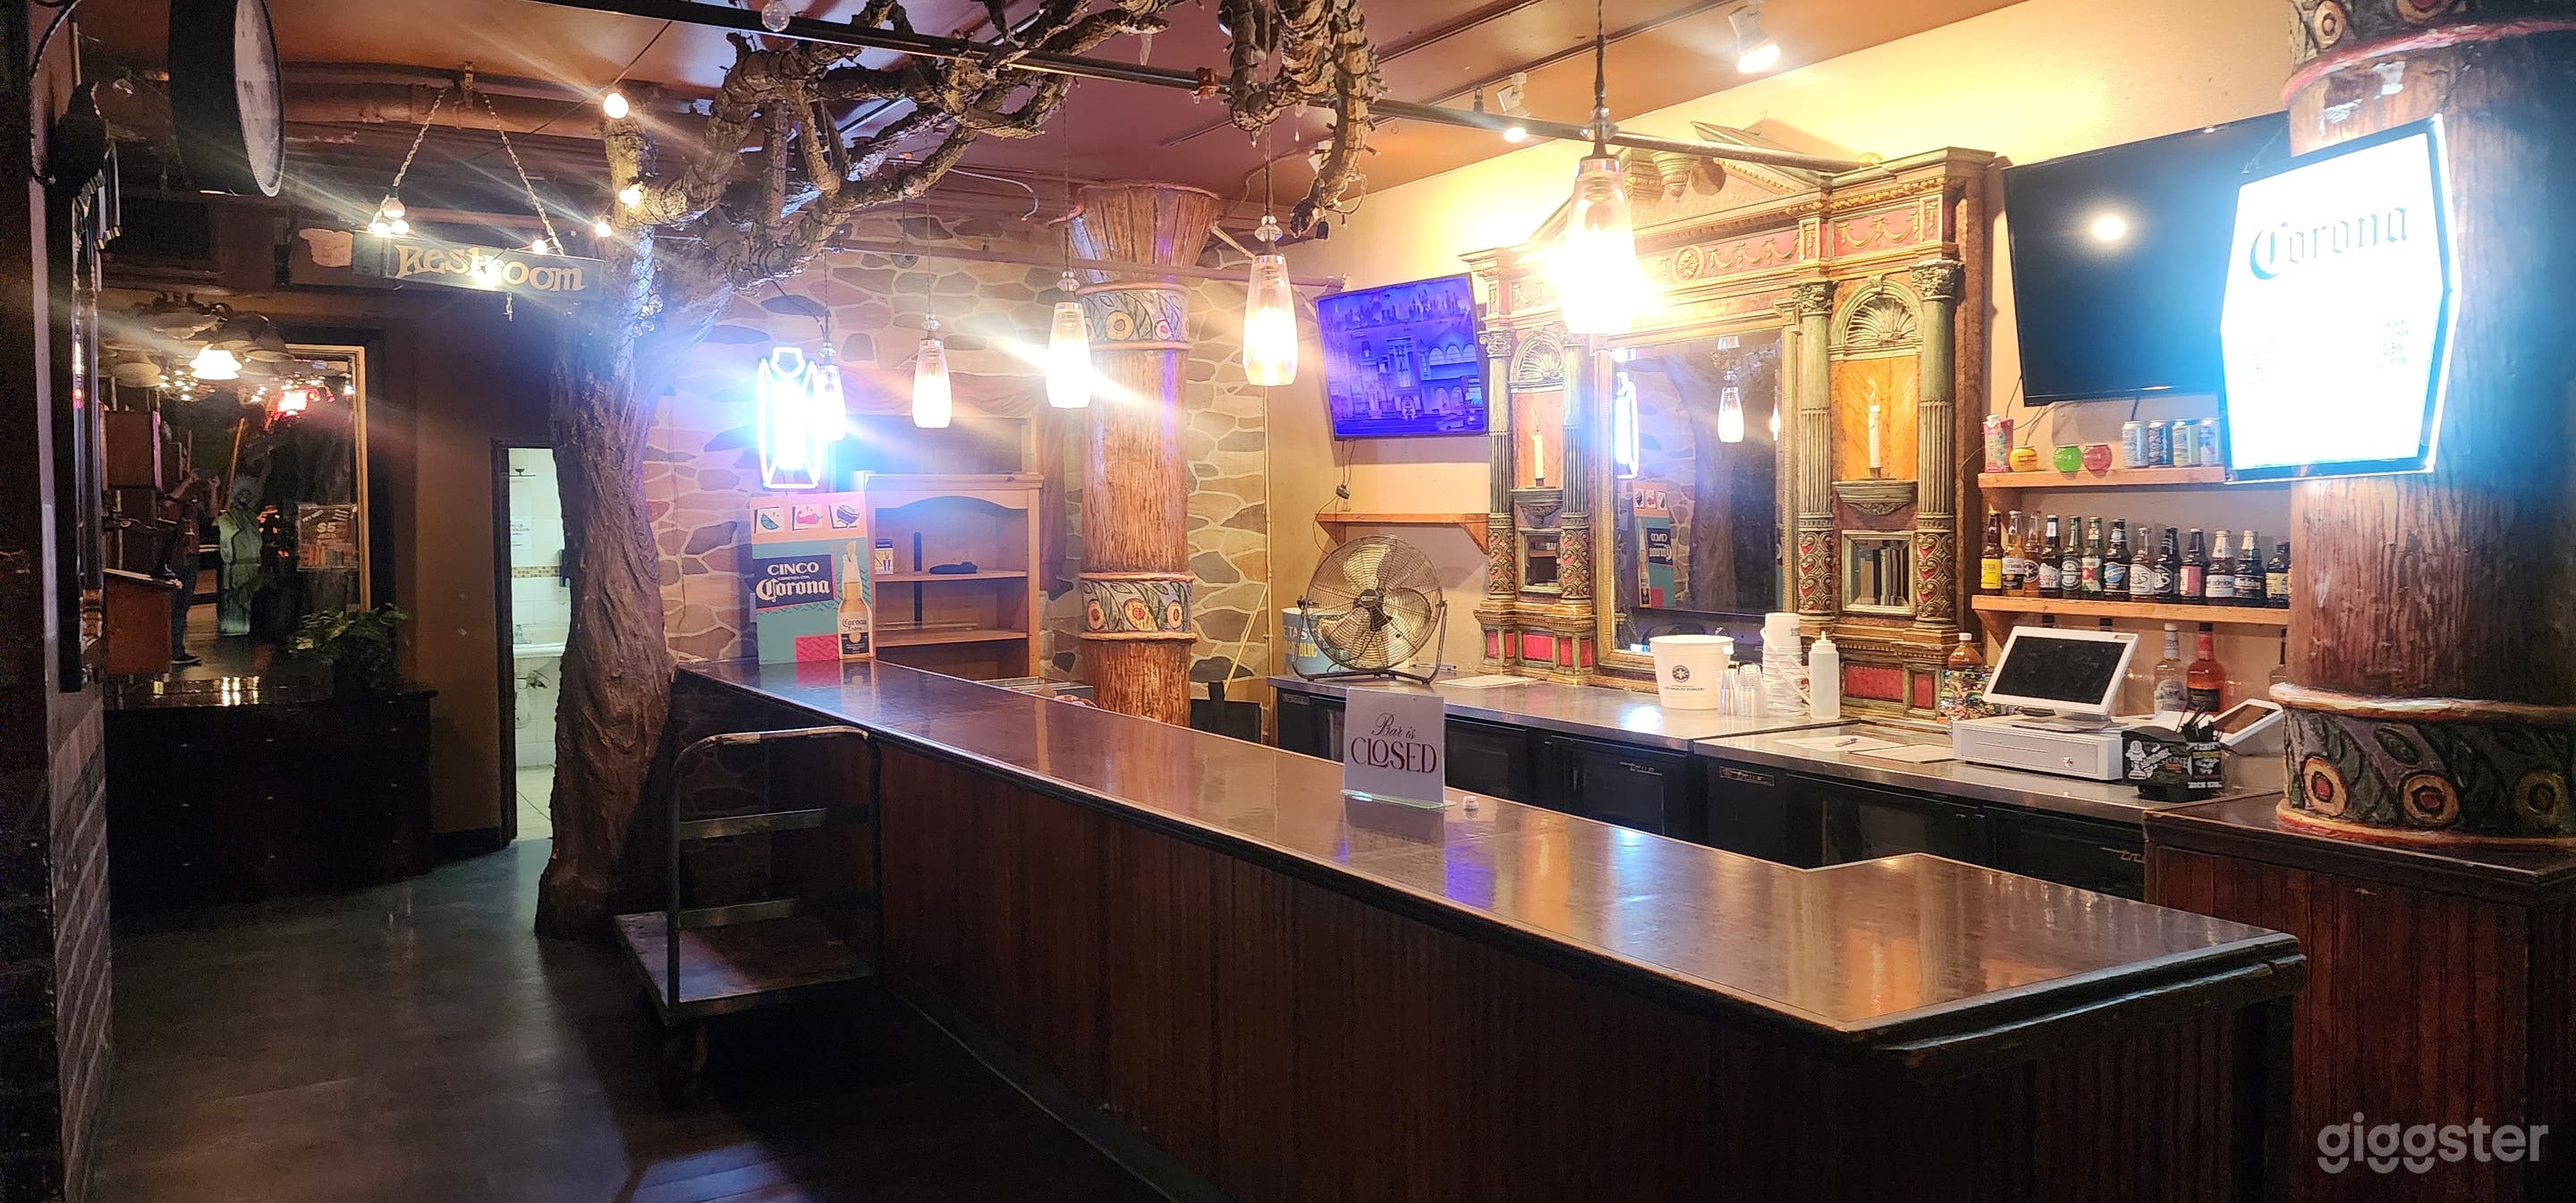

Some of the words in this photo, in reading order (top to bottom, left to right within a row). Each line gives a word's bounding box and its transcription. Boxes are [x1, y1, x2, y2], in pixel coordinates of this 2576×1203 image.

[2250, 208, 2408, 280] Corona
[394, 244, 586, 292] Restroom
[767, 562, 820, 576] CINCO
[756, 578, 831, 603] Corona
[842, 618, 867, 628] Corona
[1371, 713, 1402, 737] Bar
[1405, 726, 1417, 739] is
[1351, 737, 1437, 773] CLOSED
